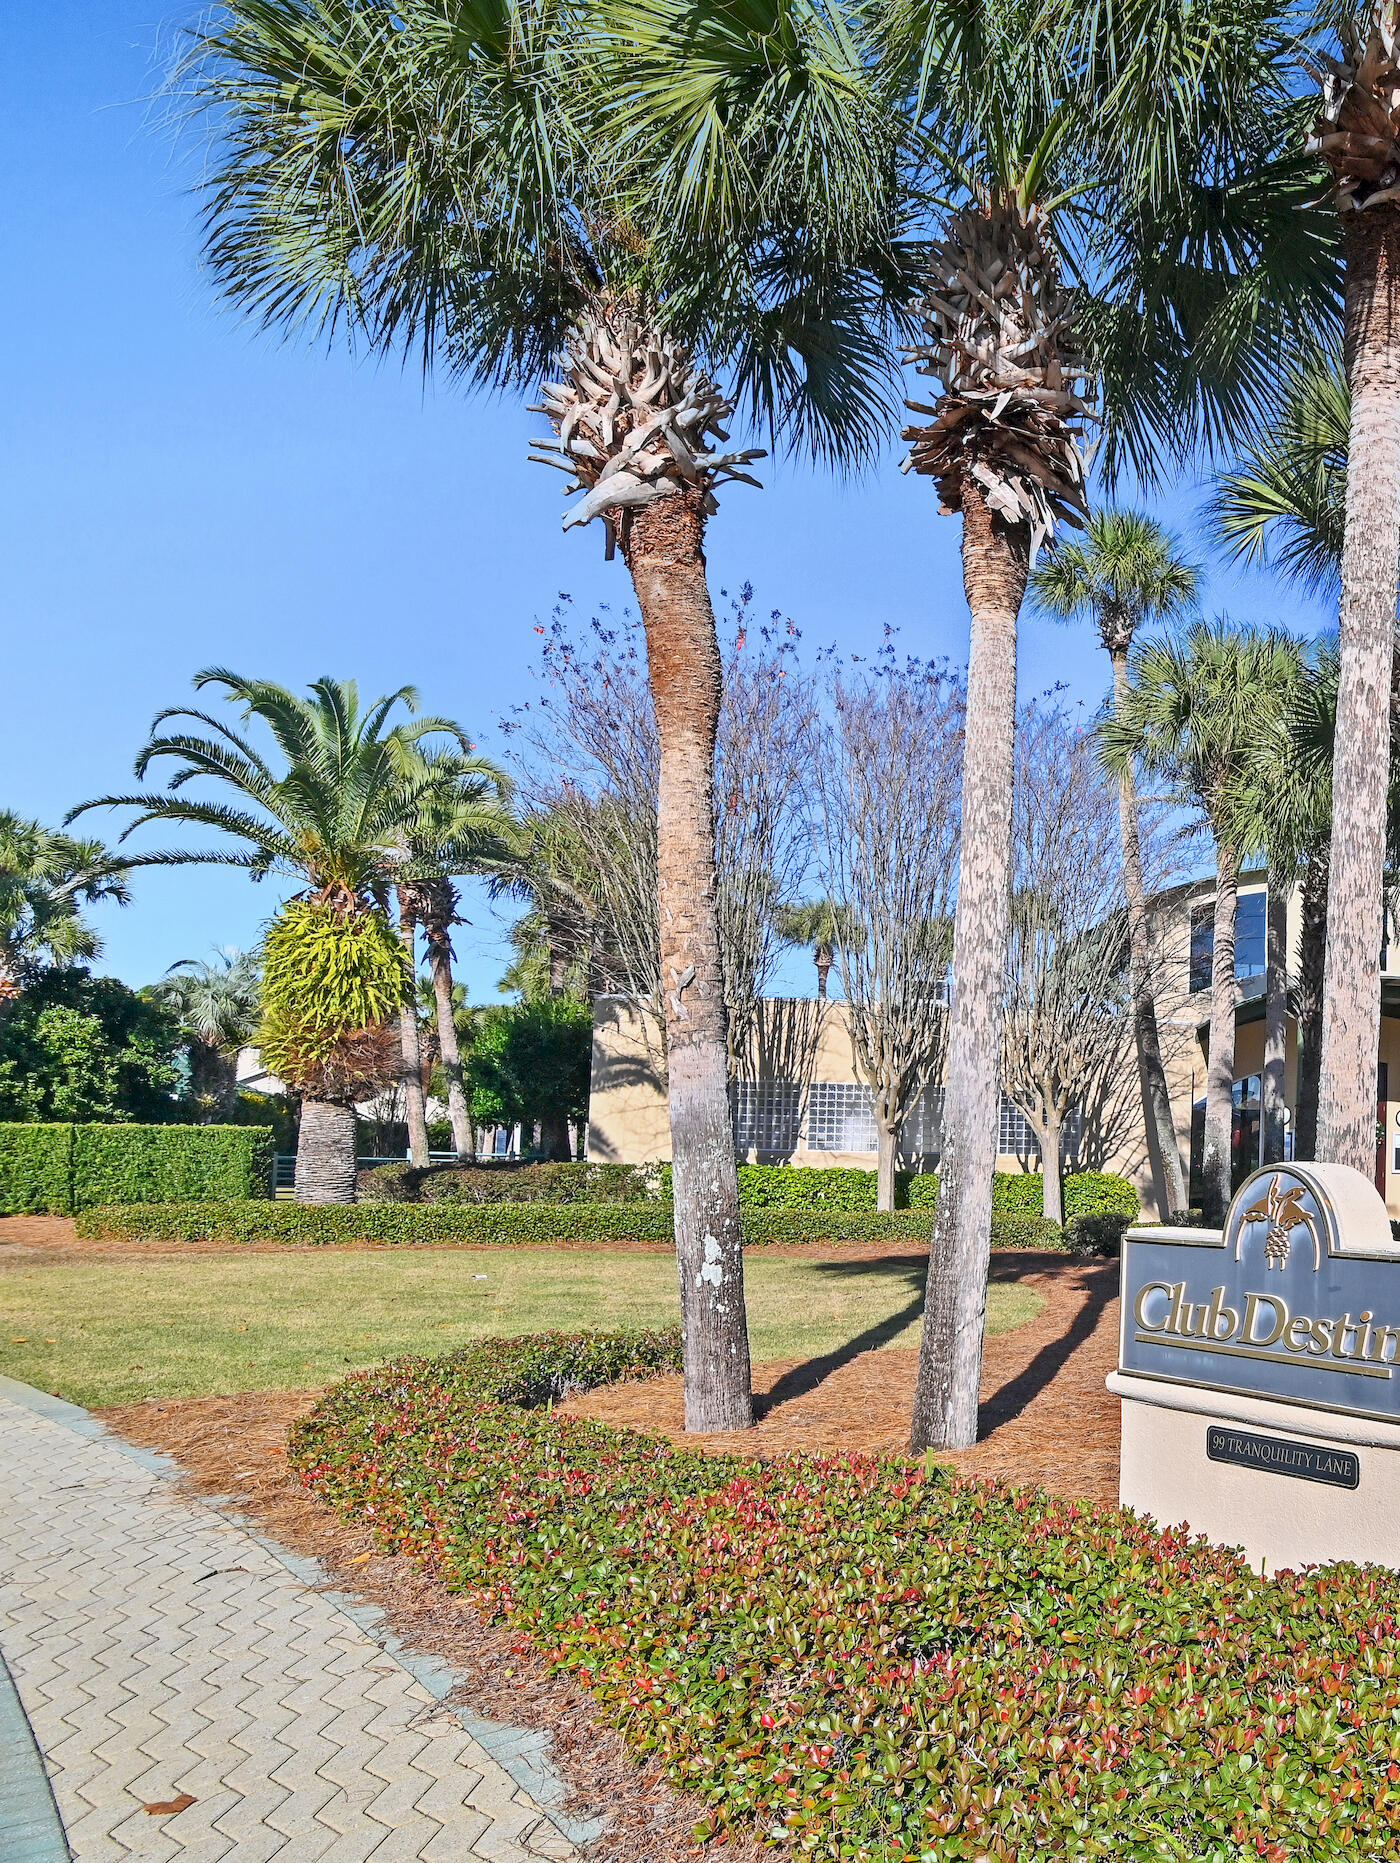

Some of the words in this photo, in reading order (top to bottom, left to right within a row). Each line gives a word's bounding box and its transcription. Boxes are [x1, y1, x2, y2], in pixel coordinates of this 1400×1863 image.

[1134, 1281, 1239, 1341] Club
[1212, 1435, 1225, 1450] 99
[1228, 1438, 1313, 1468] TRANQUILITY
[1316, 1455, 1352, 1476] LANE
